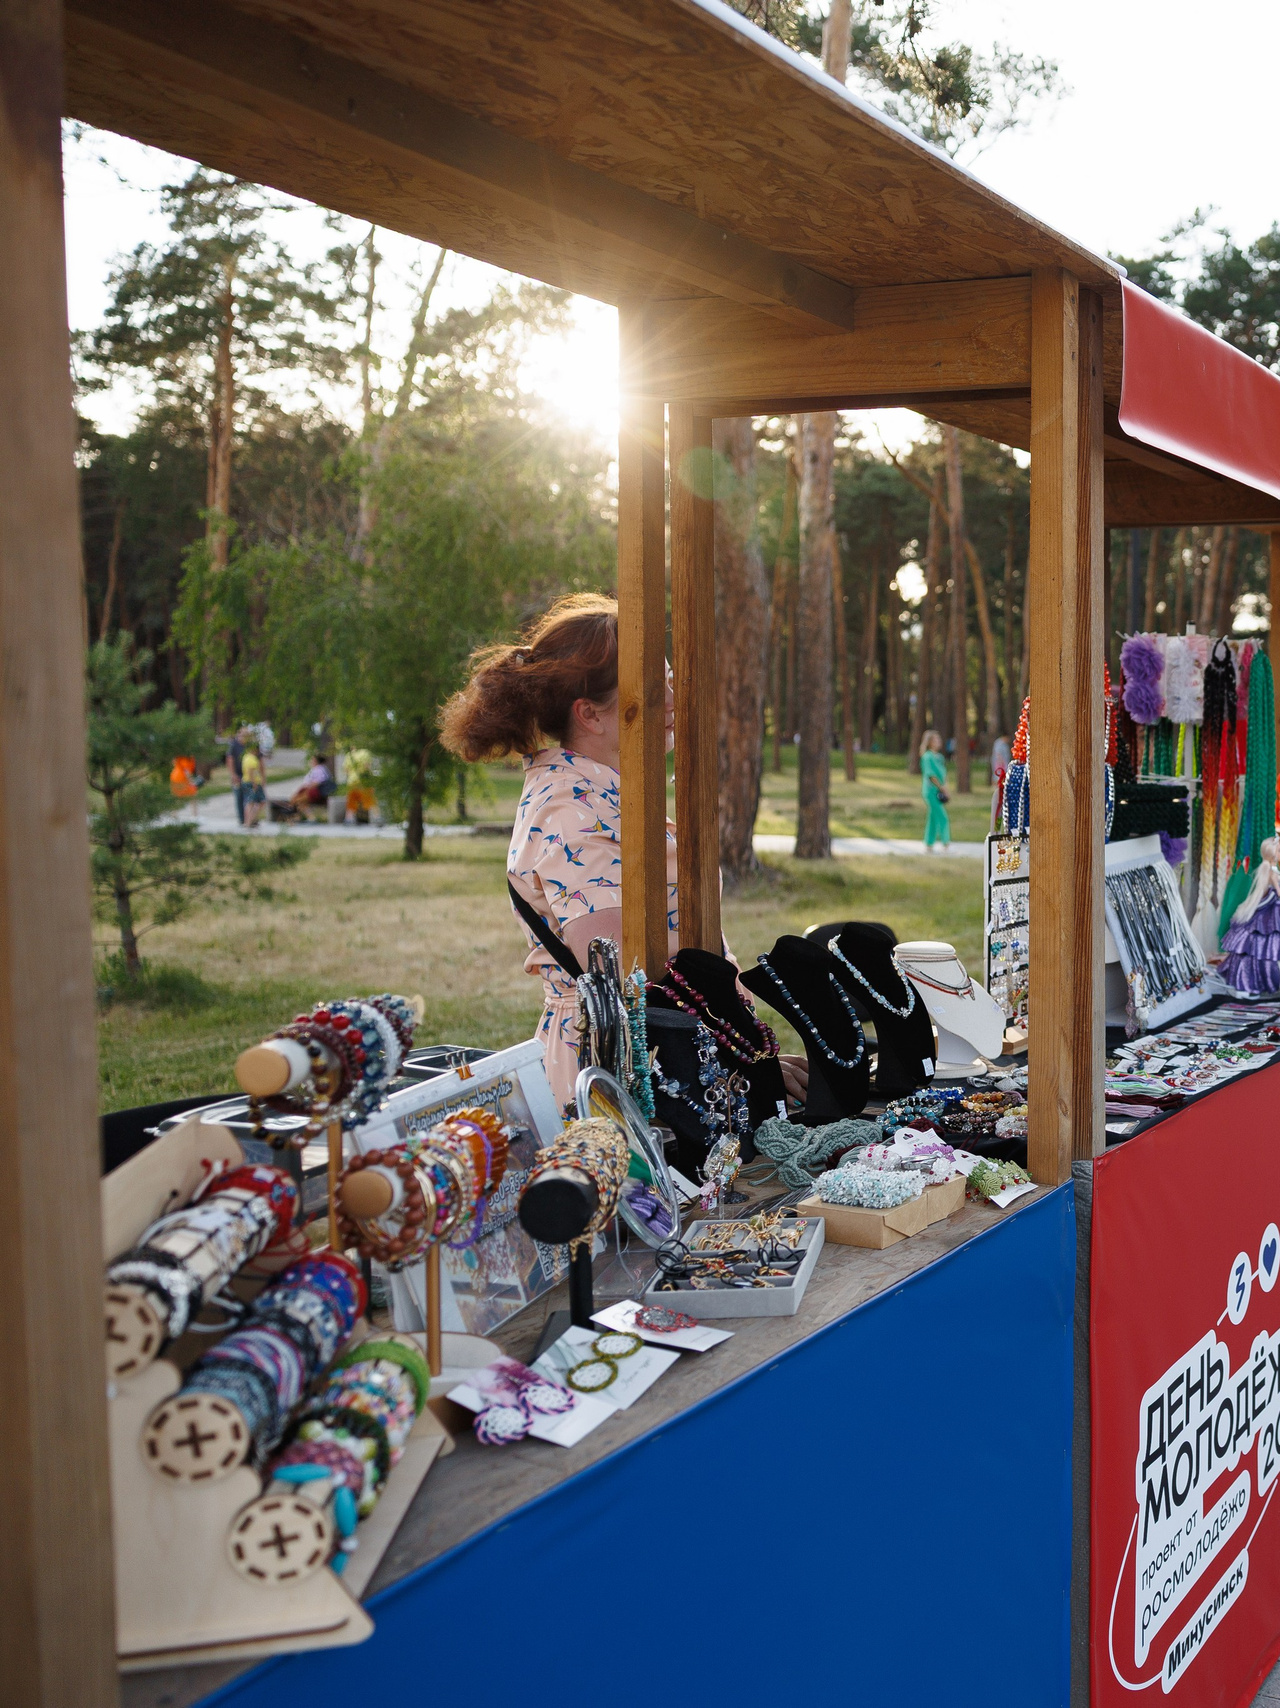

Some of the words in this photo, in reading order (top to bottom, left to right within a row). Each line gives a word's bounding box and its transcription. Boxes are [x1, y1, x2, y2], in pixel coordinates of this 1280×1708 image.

[1142, 1345, 1226, 1472] ДЕНЬ
[1140, 1488, 1248, 1648] росмолодёжь
[1141, 1528, 1182, 1591] проект
[1184, 1508, 1199, 1538] от
[1168, 1558, 1245, 1679] Минусинск
